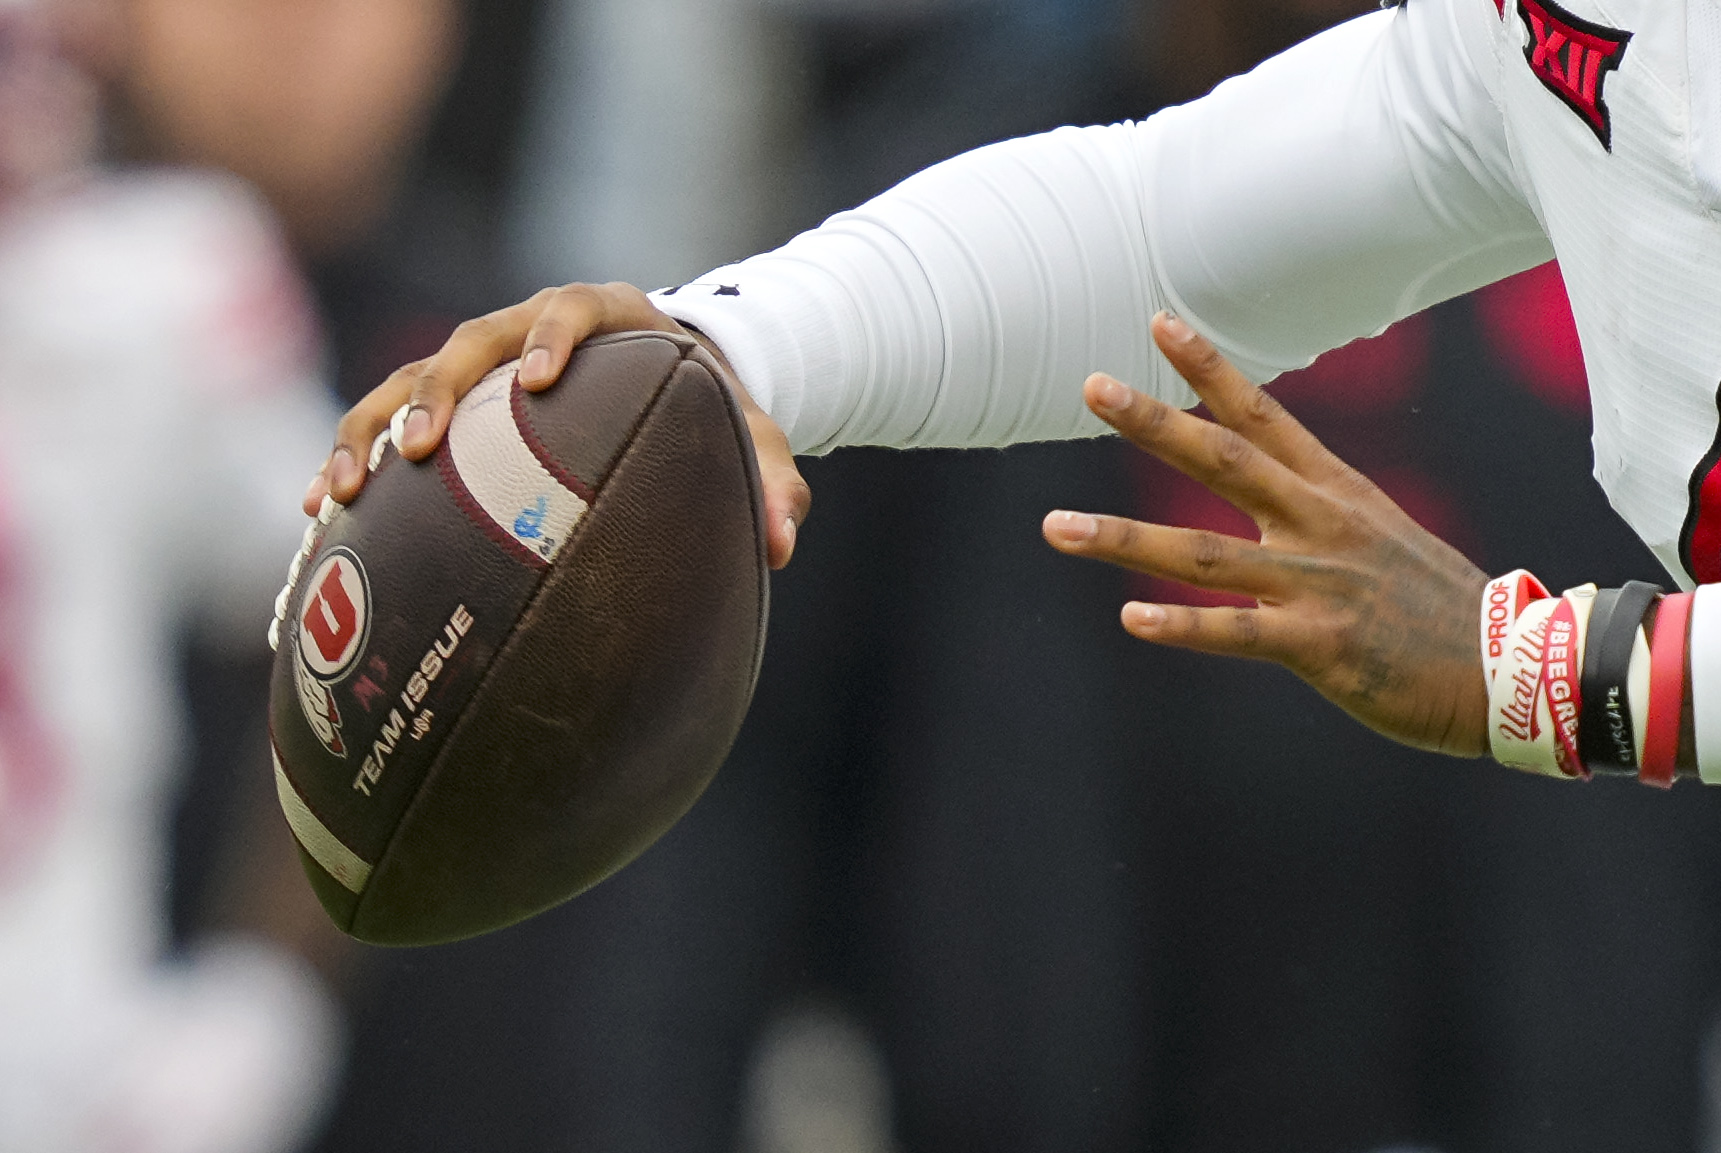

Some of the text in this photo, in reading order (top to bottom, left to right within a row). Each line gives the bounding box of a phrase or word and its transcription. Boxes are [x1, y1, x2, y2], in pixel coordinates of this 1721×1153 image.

[304, 560, 357, 663] U
[352, 706, 407, 798] TEAM
[400, 603, 475, 713] ISSUE
